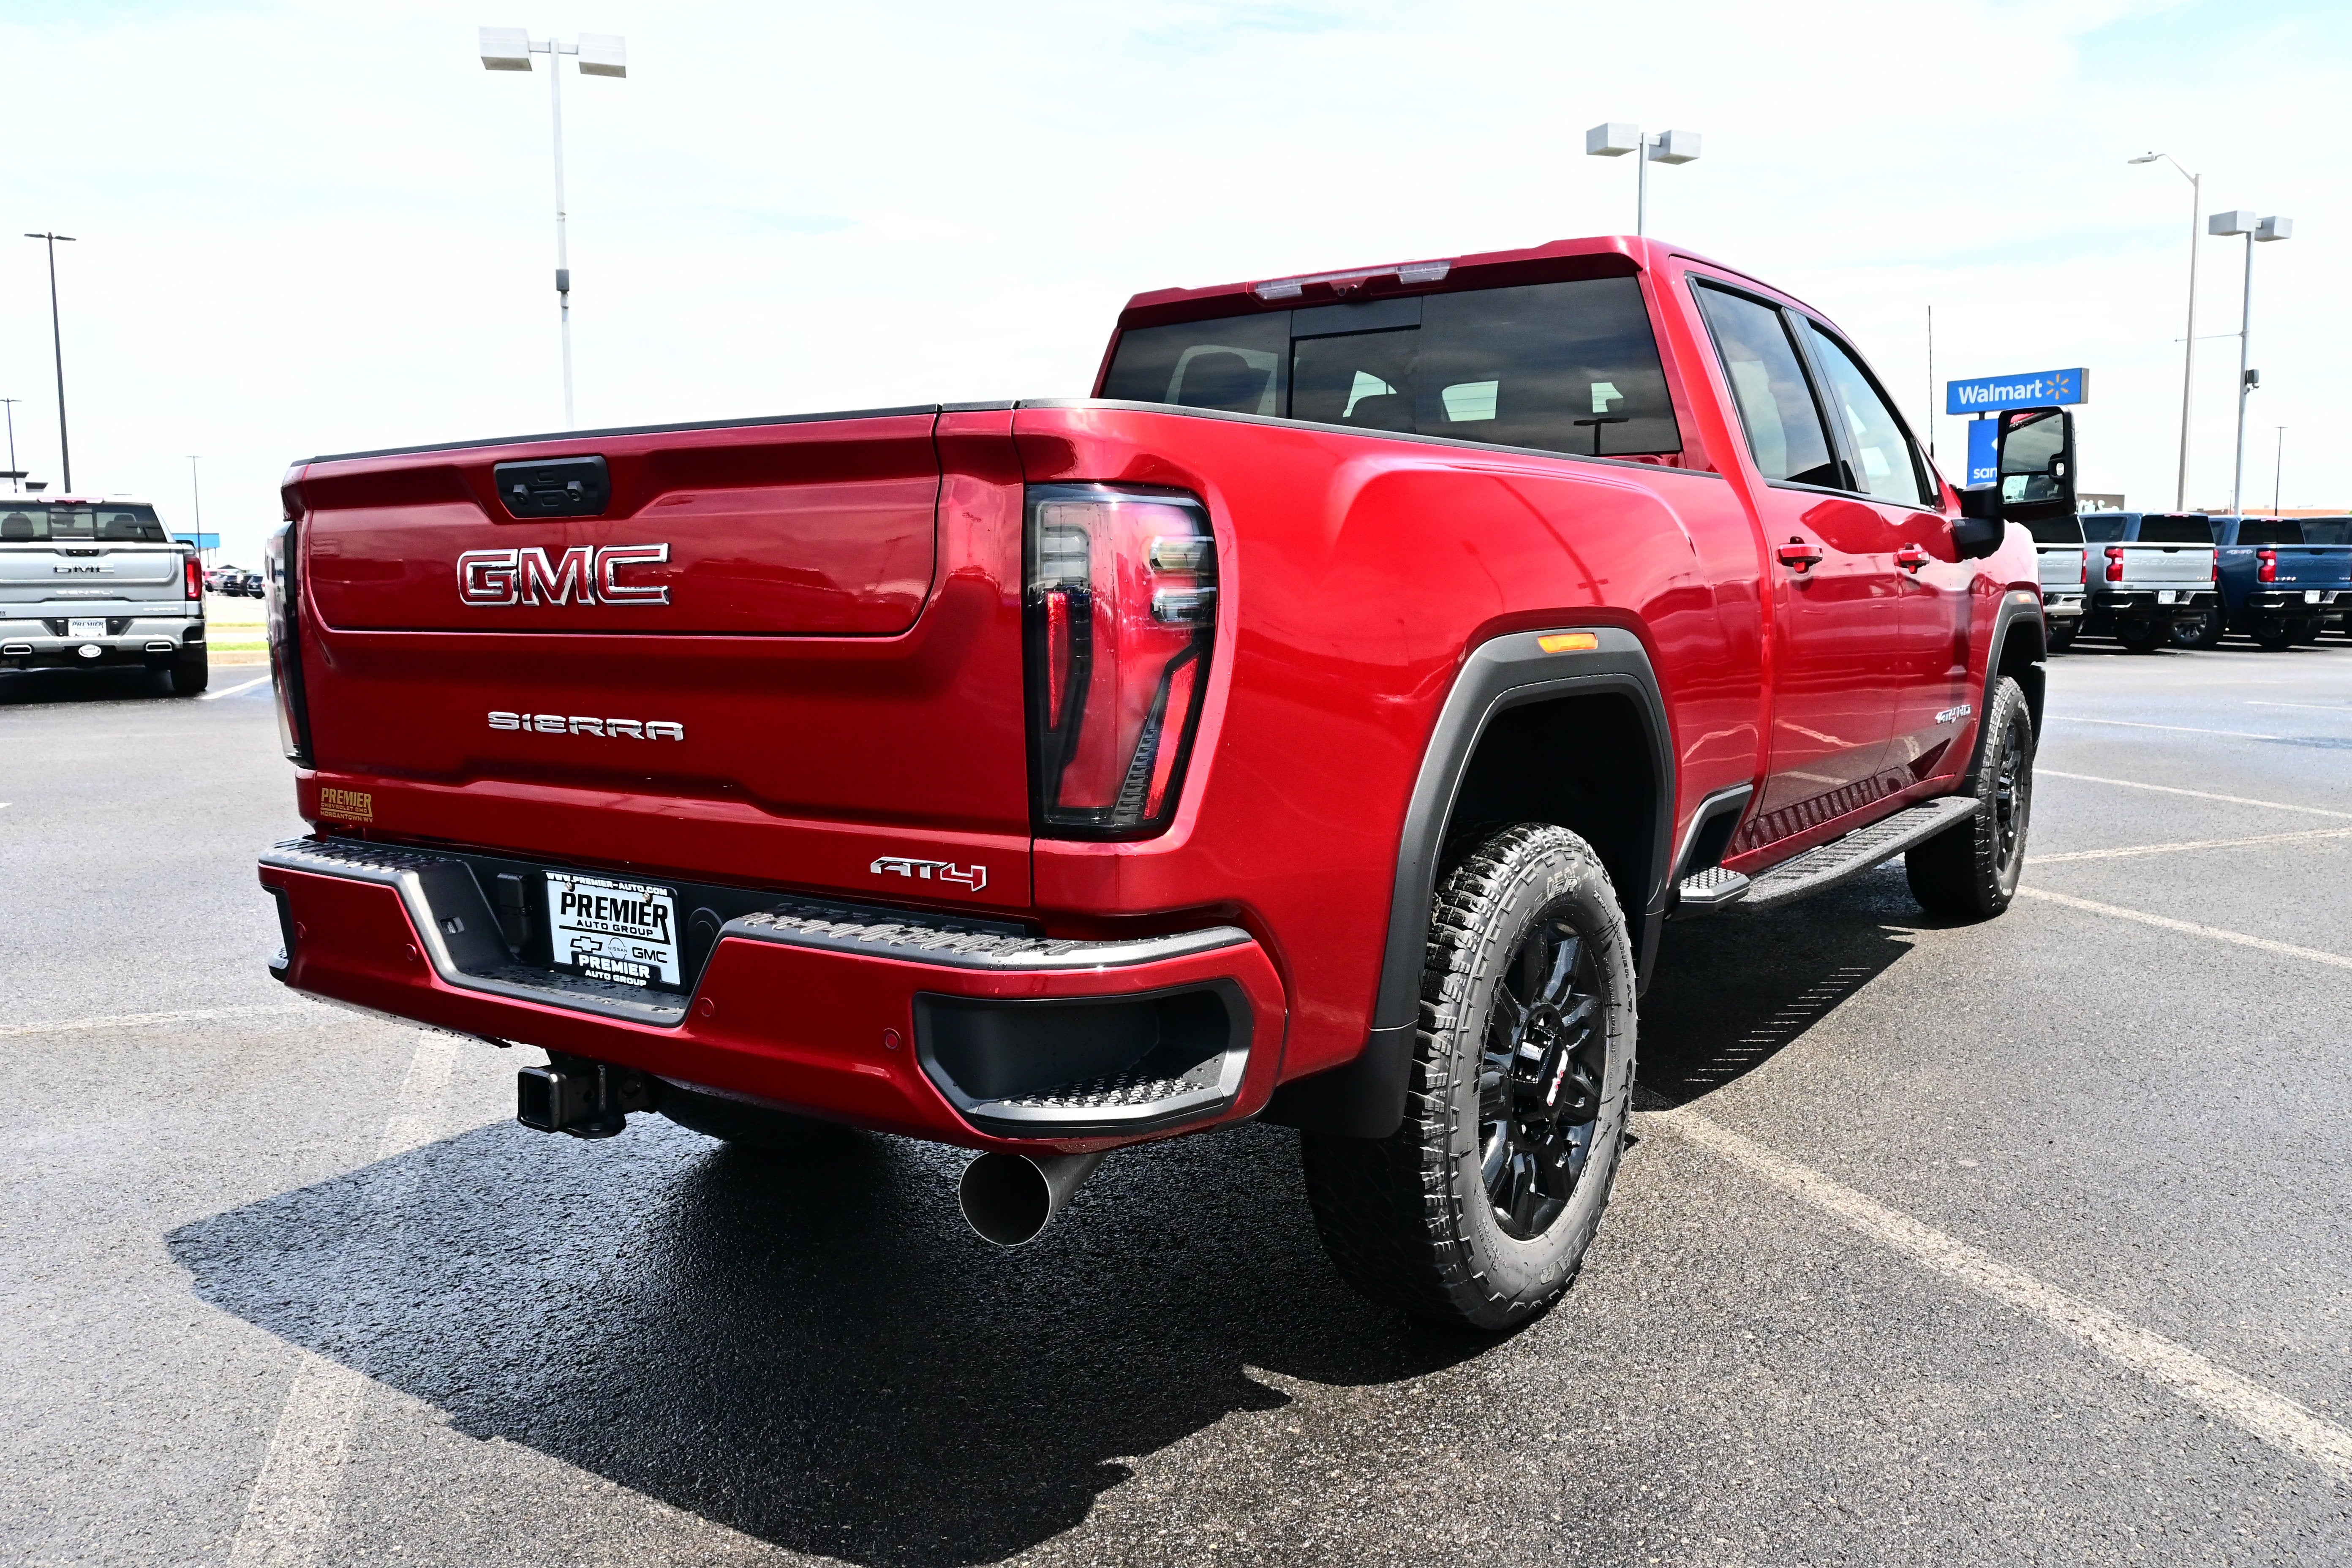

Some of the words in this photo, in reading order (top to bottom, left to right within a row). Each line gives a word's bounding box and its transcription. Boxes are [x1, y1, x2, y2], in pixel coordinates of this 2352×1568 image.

[1958, 379, 2042, 404] Walmart
[53, 563, 114, 574] GMC
[457, 543, 670, 606] GMC
[488, 711, 684, 741] SIERRA
[321, 787, 372, 808] PREMIER
[321, 802, 353, 811] CHEVROLET
[320, 810, 362, 822] MORGANTOWN
[546, 872, 667, 896] WWW.PREMIER-AUTO.COM
[870, 856, 986, 892] AT4
[561, 892, 668, 929] PREMIER
[577, 920, 608, 930] AUTO
[612, 924, 653, 936] GROUP
[579, 954, 650, 979] PREMIER
[632, 947, 667, 964] GMC
[585, 969, 611, 980] AUTO
[613, 974, 647, 987] GROUP
